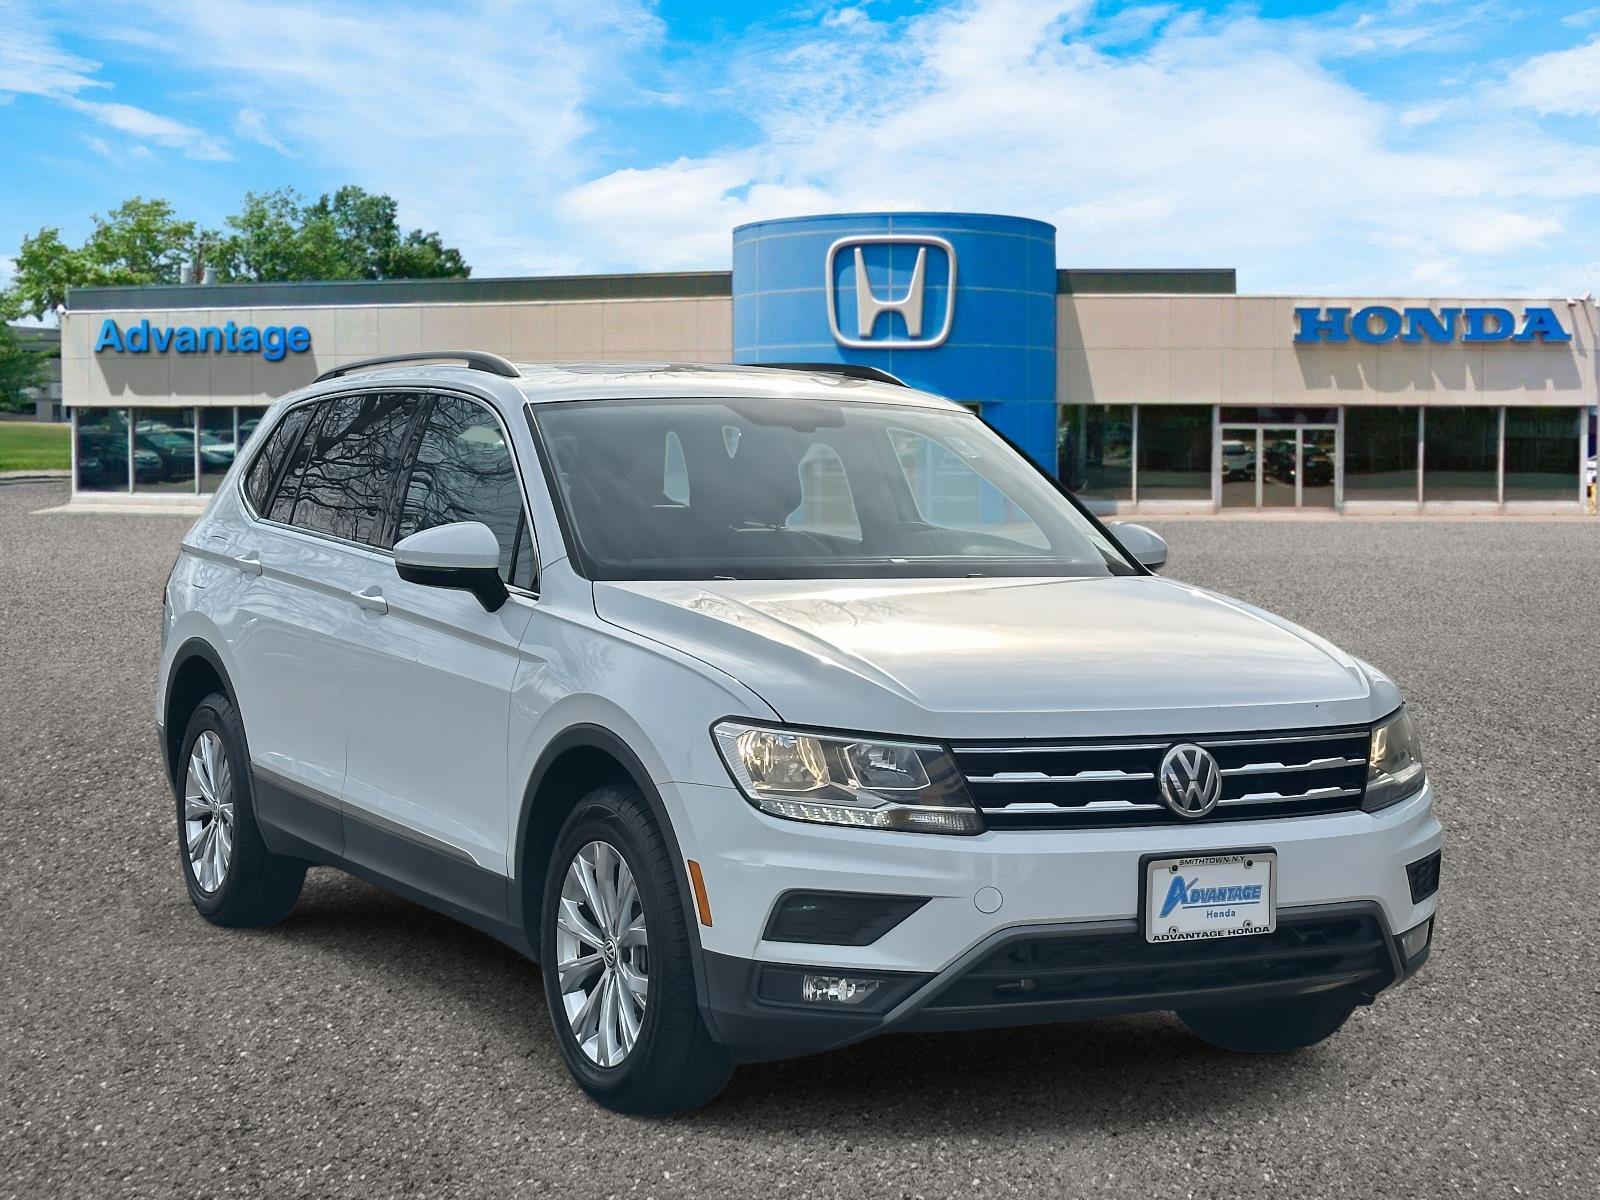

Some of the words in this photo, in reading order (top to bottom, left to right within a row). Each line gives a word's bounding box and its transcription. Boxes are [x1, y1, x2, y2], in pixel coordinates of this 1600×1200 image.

[94, 319, 311, 362] Advantage
[1294, 306, 1572, 343] HONDA
[1159, 875, 1262, 918] ADVANTAGE
[1206, 909, 1236, 919] Honda
[1152, 929, 1225, 942] ADVANTAGE
[1227, 926, 1270, 936] HONDA
